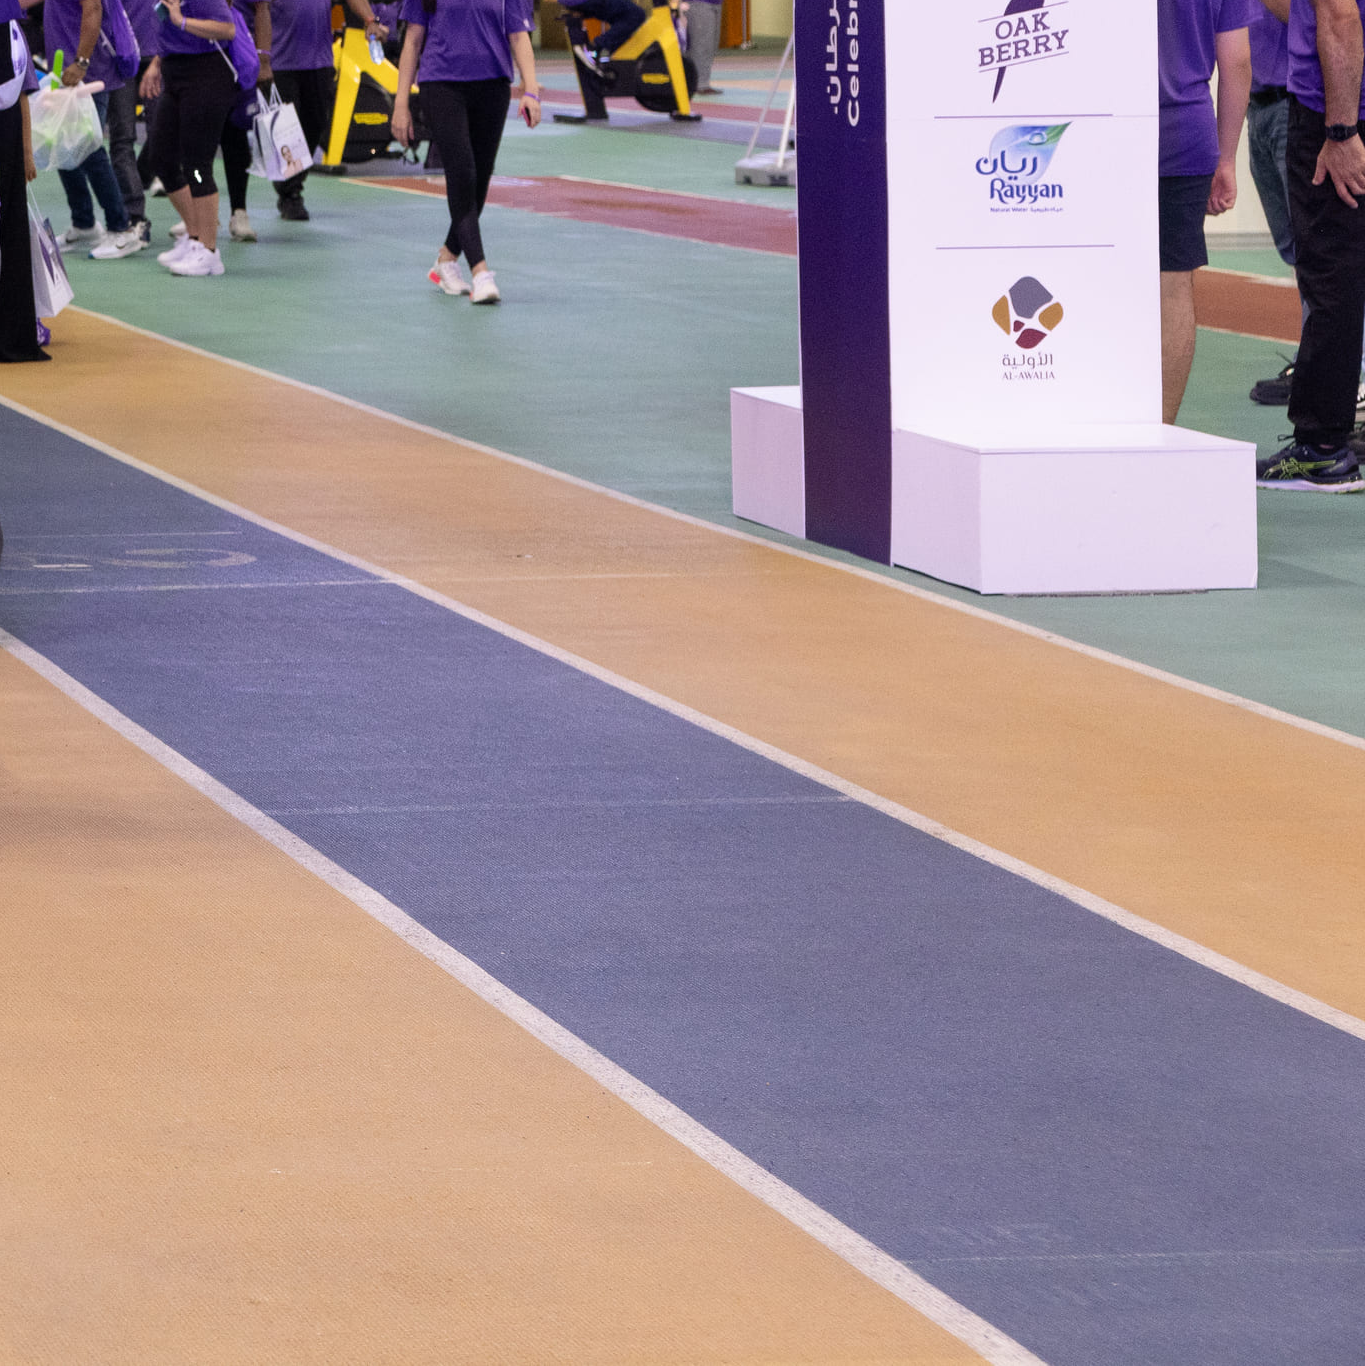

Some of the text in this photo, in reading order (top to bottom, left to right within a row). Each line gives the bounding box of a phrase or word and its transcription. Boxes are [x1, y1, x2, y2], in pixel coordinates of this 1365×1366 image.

[996, 12, 1049, 43] OAK
[979, 25, 1068, 67] BERRY
[990, 176, 1063, 204] Rayyan
[1002, 371, 1055, 381] AL-AWALIA
